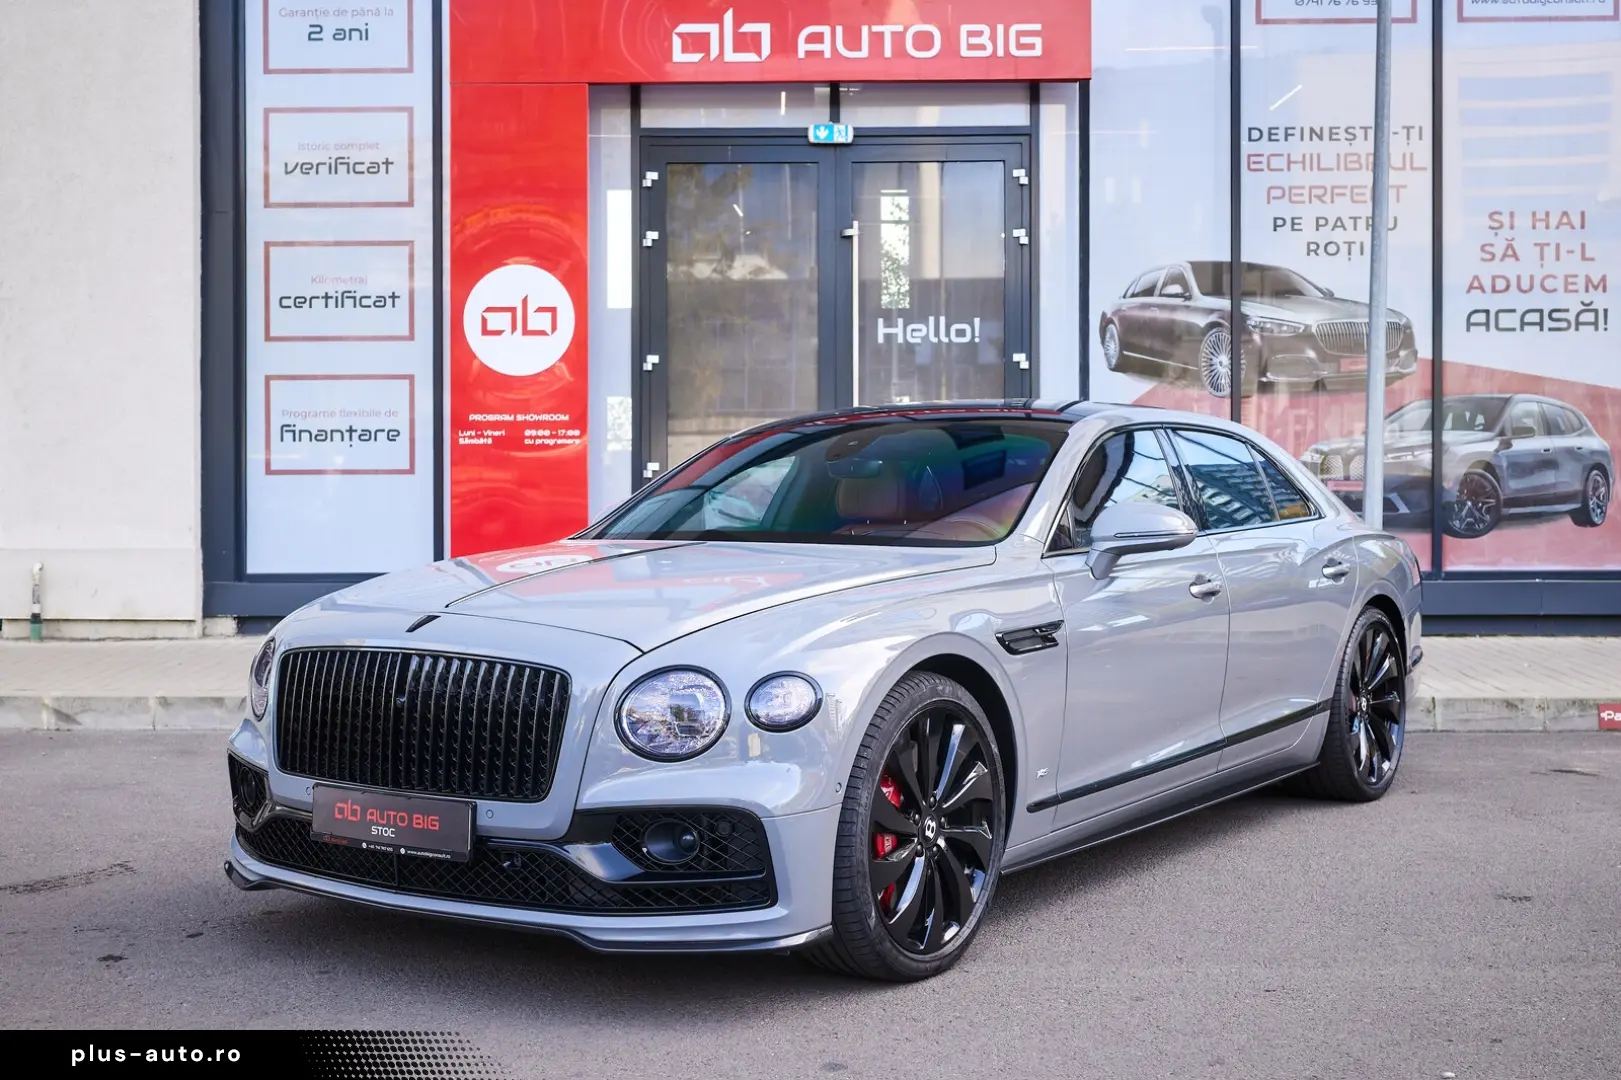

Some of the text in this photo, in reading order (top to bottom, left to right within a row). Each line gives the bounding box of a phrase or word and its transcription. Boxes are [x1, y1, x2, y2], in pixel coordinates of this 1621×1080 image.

[333, 7, 348, 17] de
[384, 7, 394, 17] la
[308, 22, 369, 41] 2 ani
[797, 25, 941, 59] AUTO
[960, 23, 1042, 58] BIG
[1247, 126, 1424, 147] DEFINEȘT-ȚI
[284, 156, 394, 175] verificat
[1266, 185, 1408, 204] PERFET
[1273, 216, 1303, 232] PE
[1488, 210, 1587, 237] ȘI HAI
[1306, 241, 1364, 261] ROȚI
[1480, 238, 1596, 268] SĂ ȚI-L
[311, 274, 367, 286] Kilometraj
[1465, 274, 1608, 294] ADUCEM
[279, 290, 401, 309] certificat
[1465, 301, 1609, 332] ACASĂ!
[877, 316, 981, 343] Hello!
[384, 407, 399, 418] de
[468, 413, 570, 421] PROGRAM SHOWROOM
[280, 424, 401, 448] finanțare
[458, 429, 475, 437] Luni
[366, 808, 409, 827] AUTO
[412, 814, 440, 831] BIG
[371, 825, 396, 838] STOC
